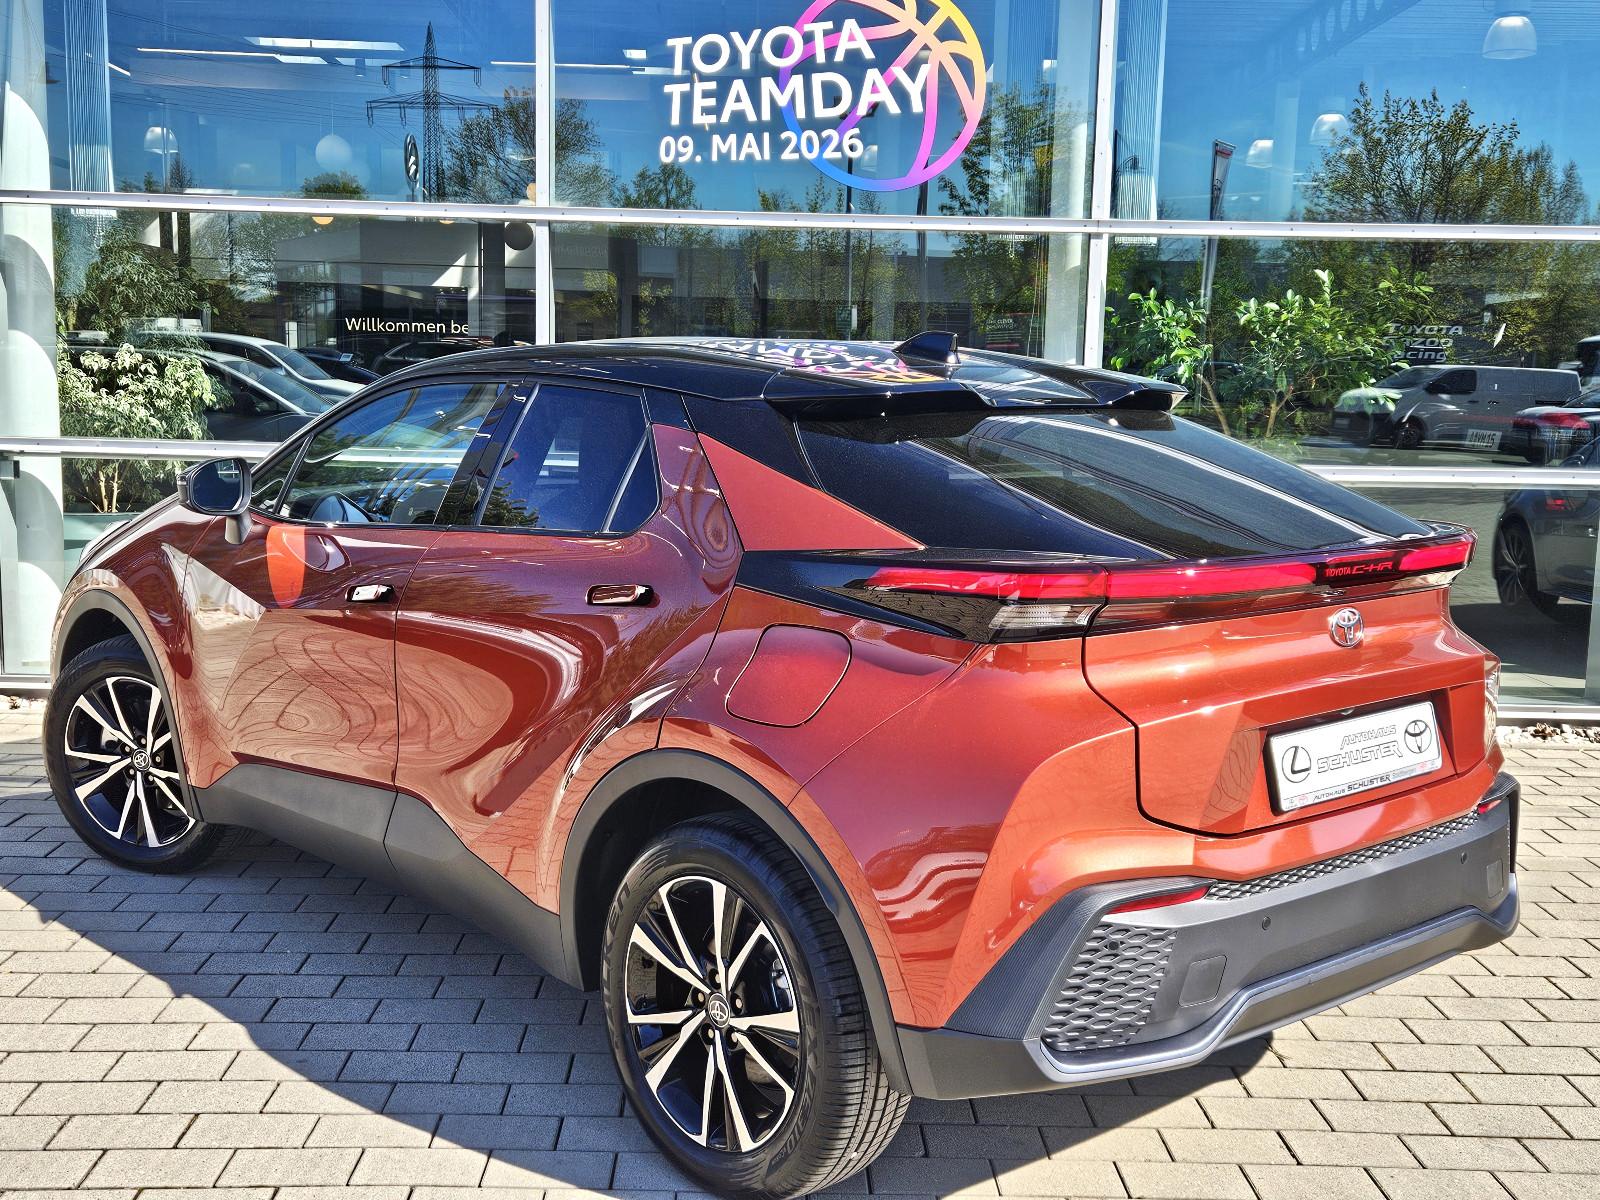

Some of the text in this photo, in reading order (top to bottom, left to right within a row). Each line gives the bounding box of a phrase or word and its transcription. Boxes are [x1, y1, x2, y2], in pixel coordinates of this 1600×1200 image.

[666, 18, 875, 76] TOYOTA
[663, 63, 931, 126] TEAMDAY
[659, 127, 864, 163] 09. MAI 2026
[345, 317, 446, 333] Willkommen
[1325, 561, 1393, 577] TOYOTA C-HR
[1340, 724, 1397, 751] AUTOHAUS
[1316, 740, 1404, 774] SCHUSTER
[1347, 774, 1392, 791] SCHUSTER
